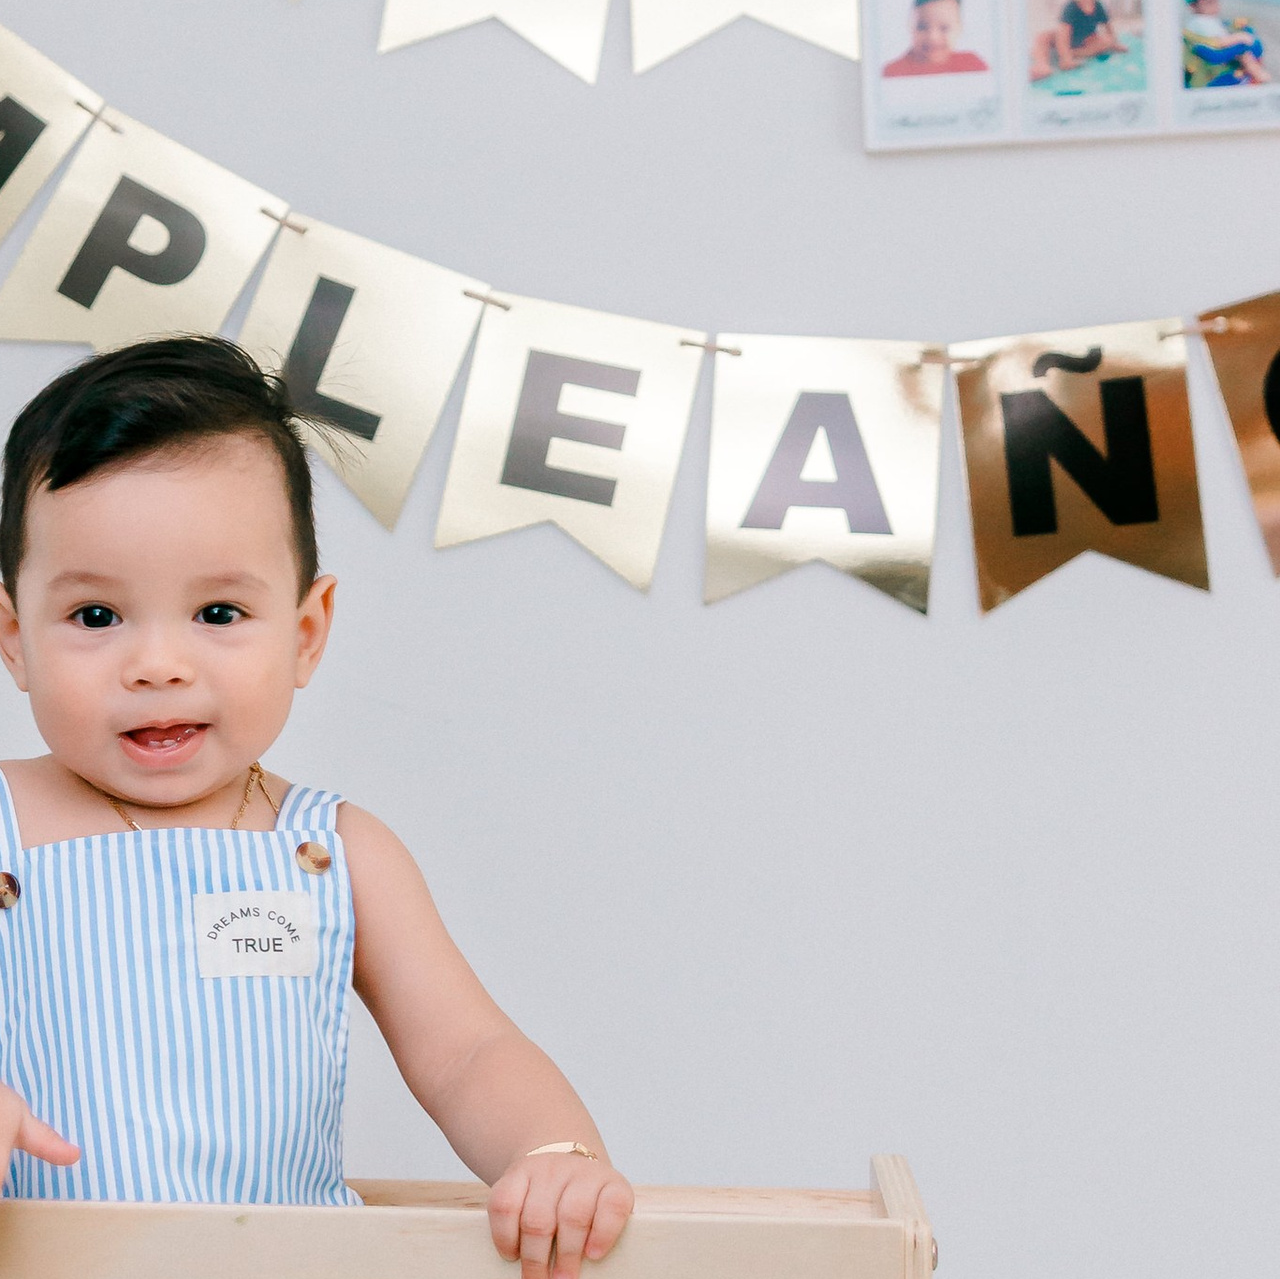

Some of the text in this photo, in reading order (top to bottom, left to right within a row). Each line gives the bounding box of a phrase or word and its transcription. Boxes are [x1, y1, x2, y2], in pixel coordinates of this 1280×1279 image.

[207, 907, 300, 944] DREAMS COME
[232, 938, 283, 953] TRUE
